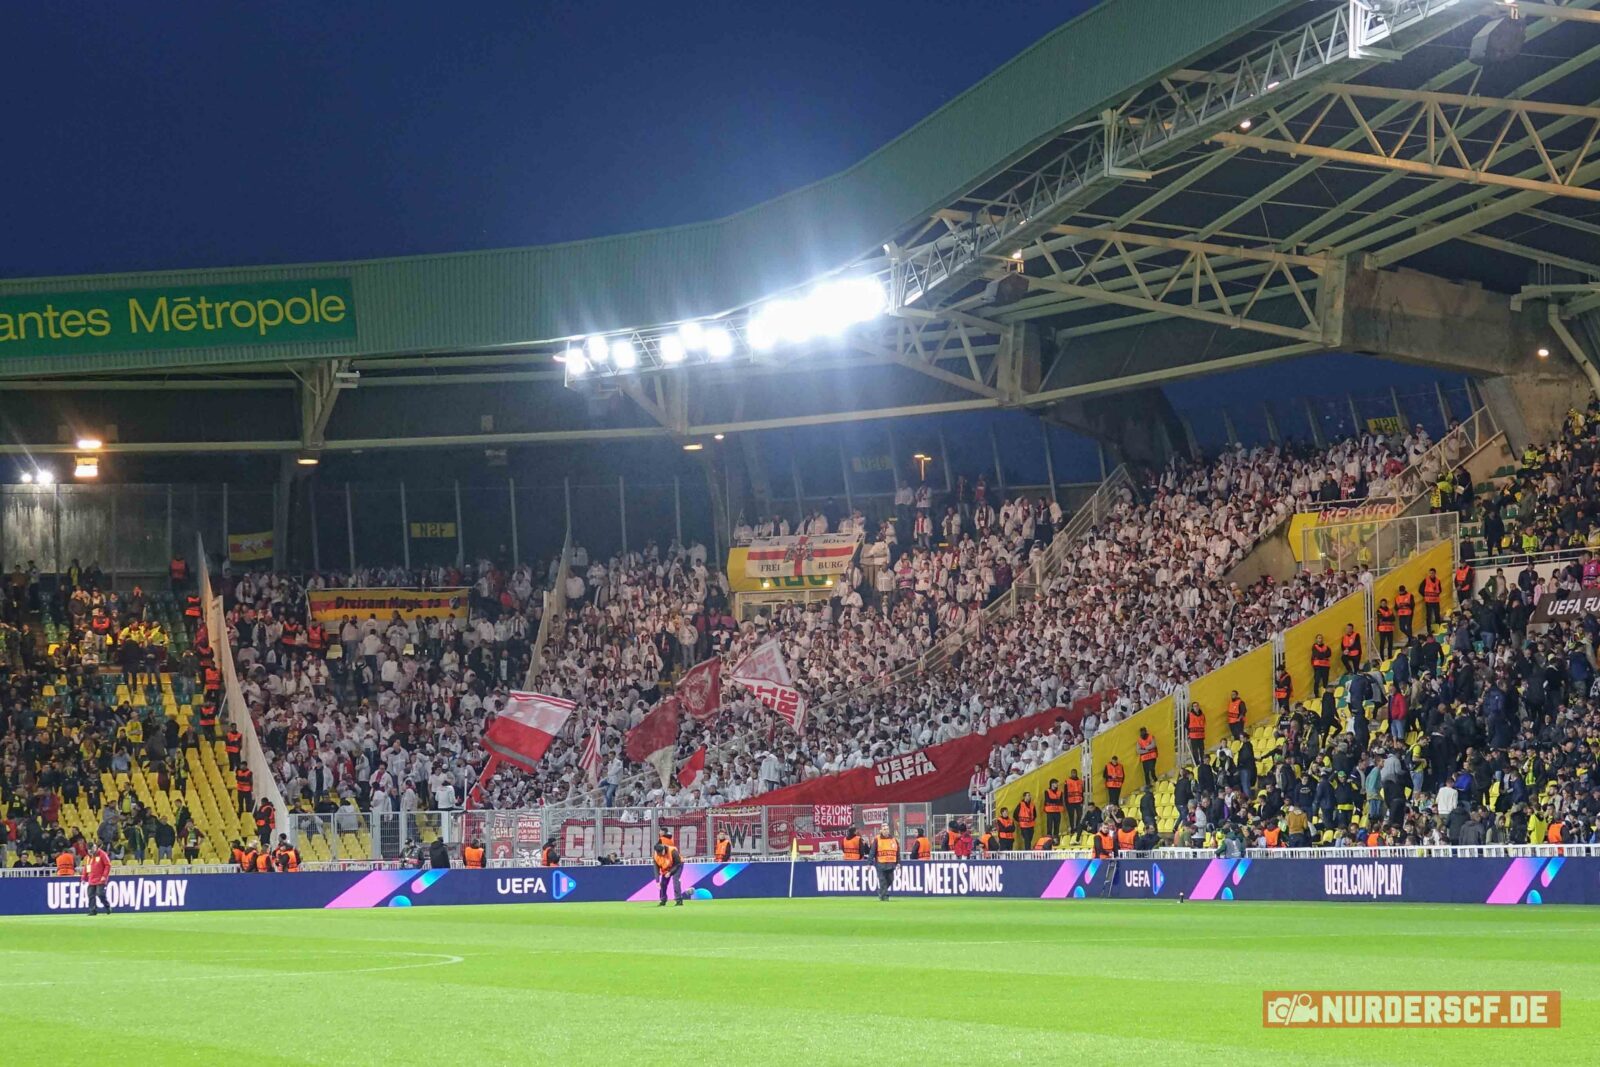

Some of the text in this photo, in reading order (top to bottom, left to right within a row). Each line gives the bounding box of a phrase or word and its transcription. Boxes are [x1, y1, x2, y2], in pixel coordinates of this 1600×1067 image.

[818, 560, 843, 569] BURG
[1547, 599, 1581, 616] UEFA
[877, 752, 928, 774] UEFA
[875, 761, 937, 786] MAFIA
[814, 805, 852, 815] SEZIONE
[814, 815, 852, 826] BERLINO
[497, 878, 547, 894] UEFA
[815, 862, 1003, 895] WHERE FOBALL MEETS MUSIC
[1125, 870, 1151, 888] UEFA
[1324, 861, 1403, 899] UEFA.COM/PLAY
